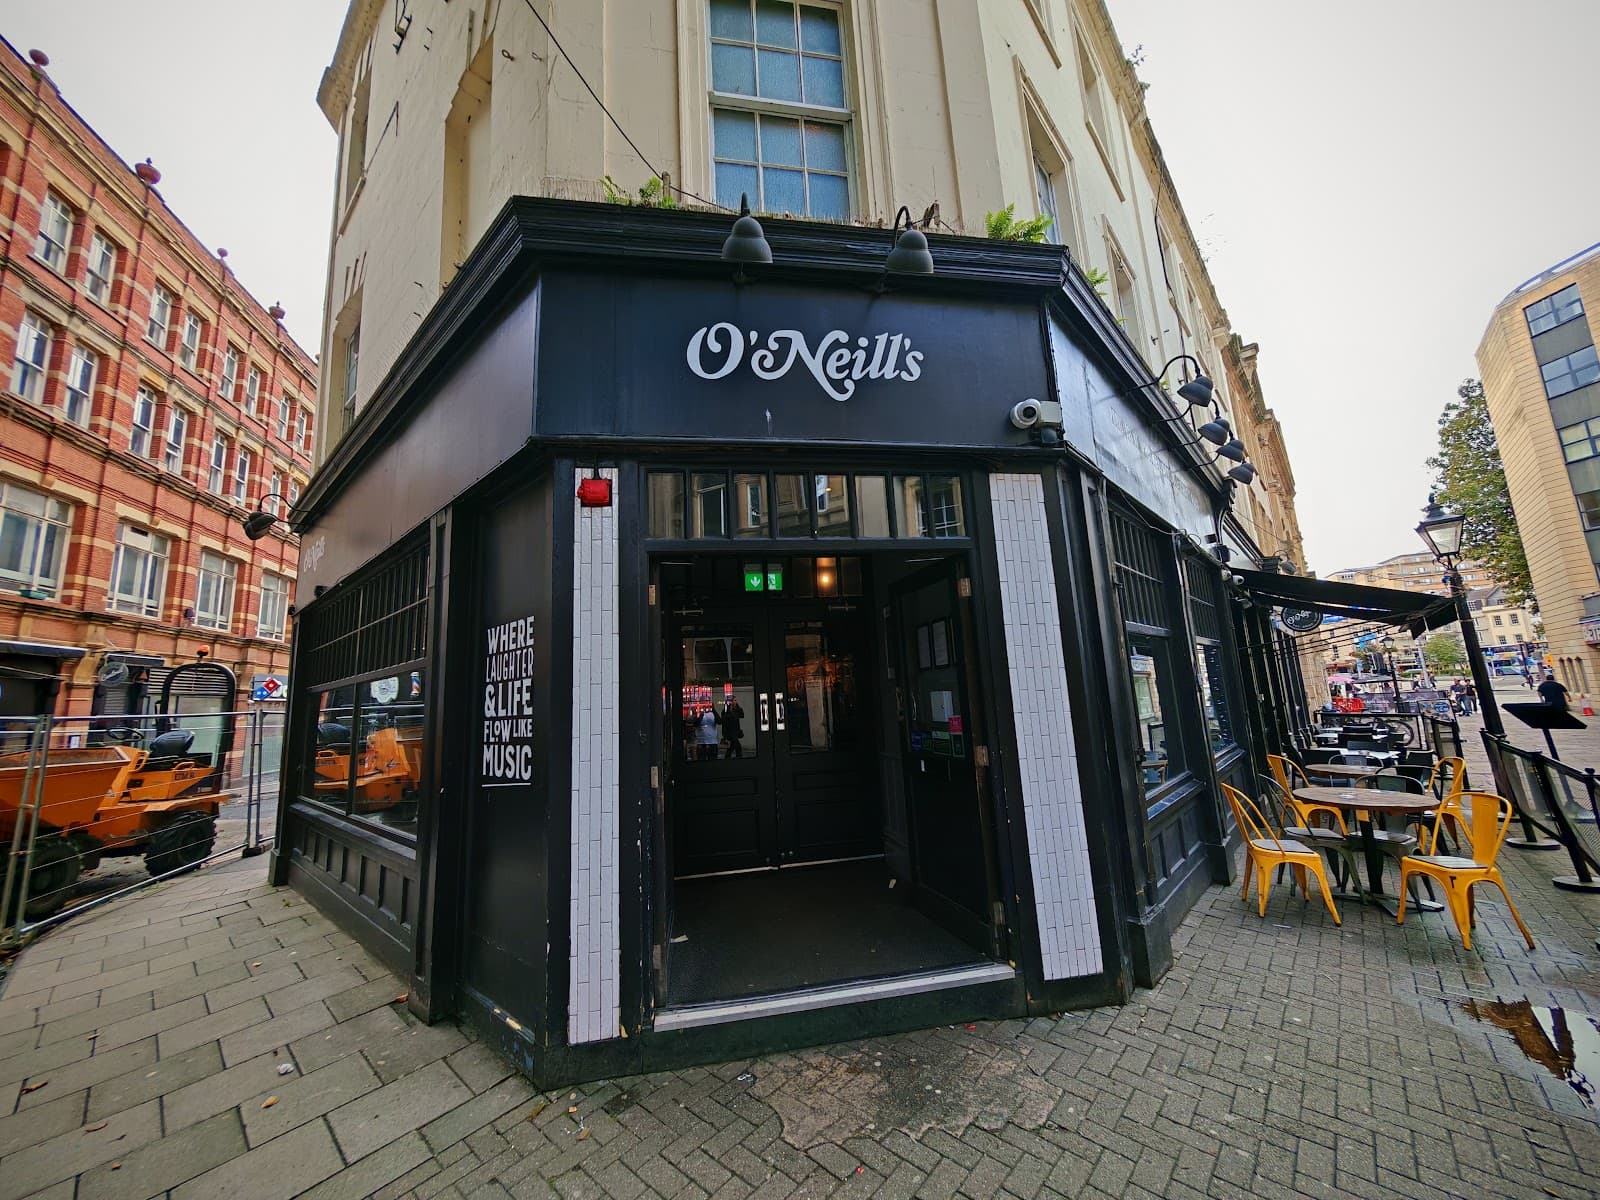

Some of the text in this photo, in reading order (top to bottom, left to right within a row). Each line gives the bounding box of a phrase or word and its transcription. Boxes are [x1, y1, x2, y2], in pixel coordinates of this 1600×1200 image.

[686, 322, 924, 401] O'Neill's
[487, 615, 535, 655] WHERE
[485, 647, 534, 683] LAUGHTER
[483, 718, 533, 743] FLOW LIKE
[482, 744, 532, 781] MUSIC
